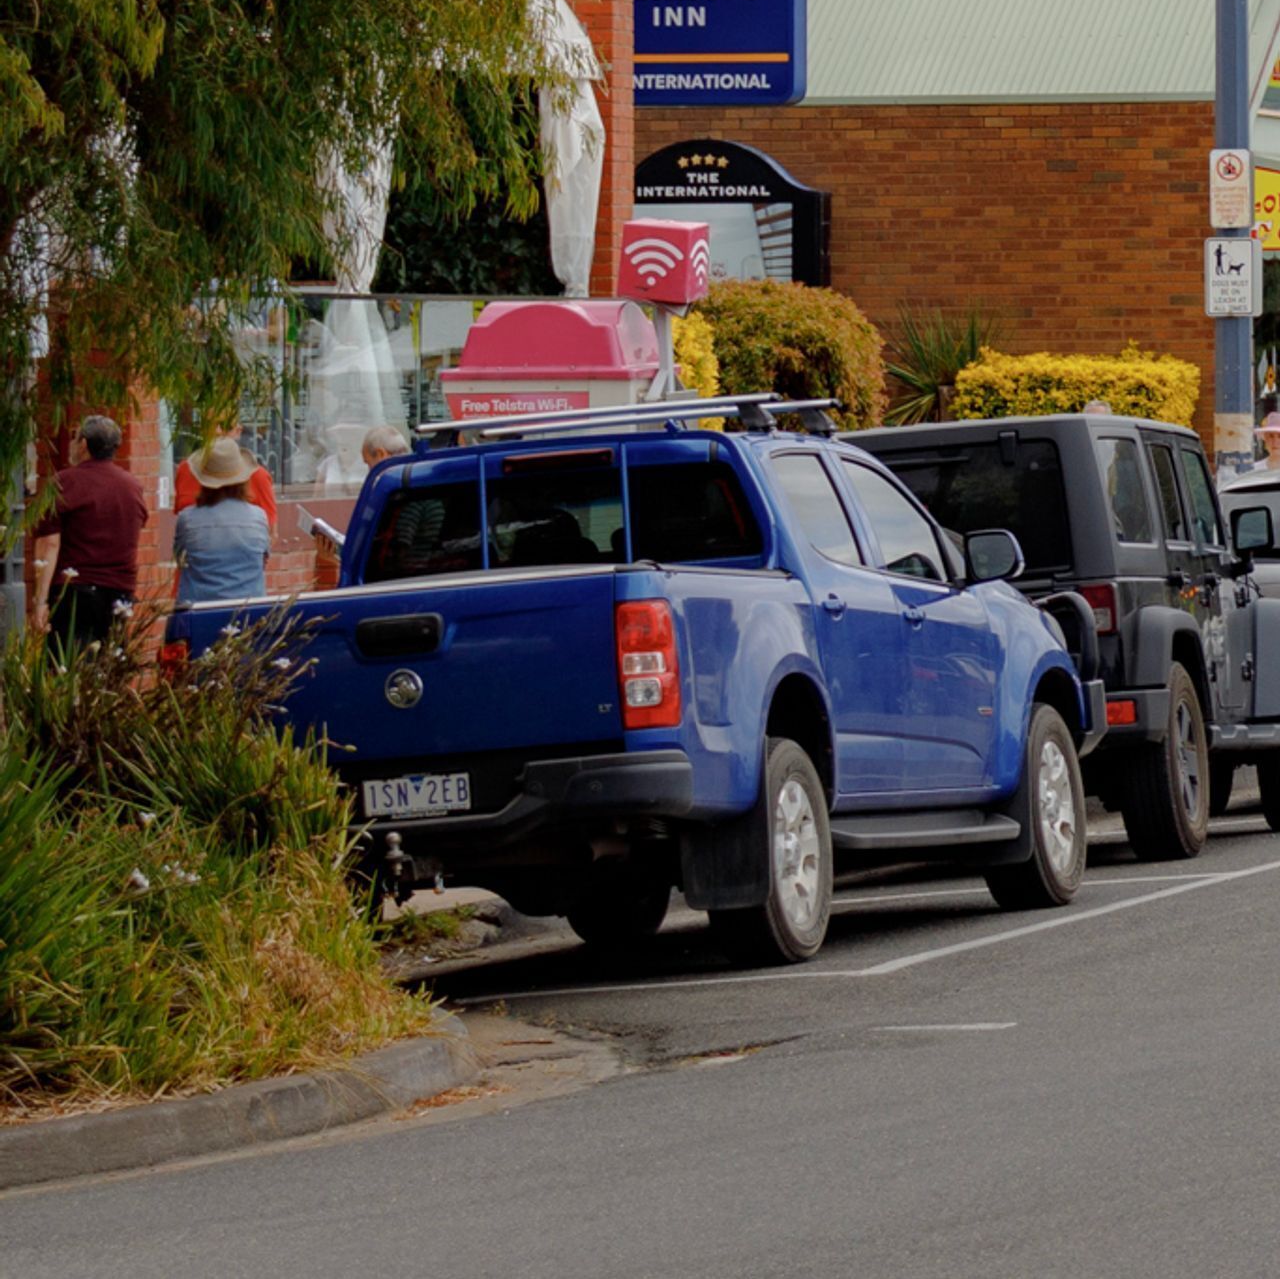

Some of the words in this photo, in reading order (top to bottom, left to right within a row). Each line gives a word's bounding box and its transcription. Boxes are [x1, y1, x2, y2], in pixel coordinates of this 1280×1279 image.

[653, 6, 706, 27] INN
[633, 74, 771, 89] NTERNATIONAL
[686, 173, 720, 184] THE
[636, 186, 771, 197] INTERNATIONAL
[461, 400, 490, 411] Free
[492, 399, 535, 411] Telstra
